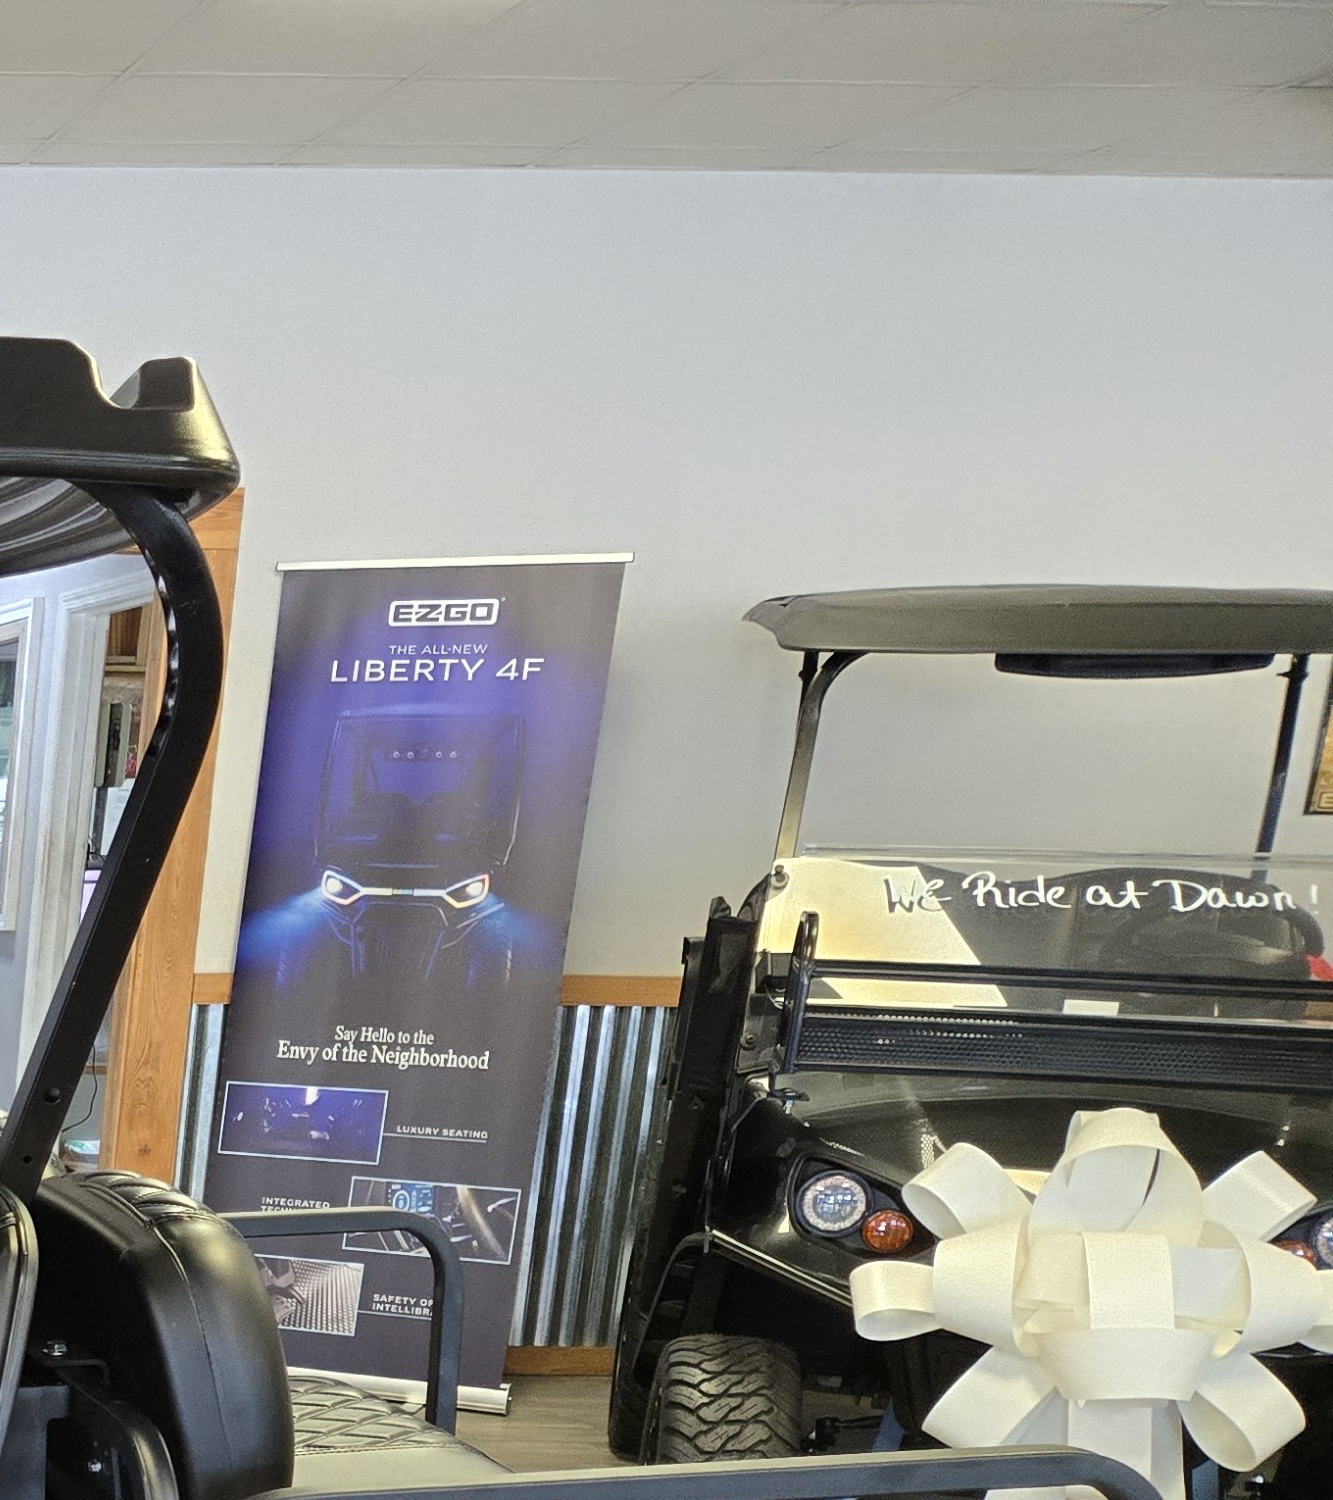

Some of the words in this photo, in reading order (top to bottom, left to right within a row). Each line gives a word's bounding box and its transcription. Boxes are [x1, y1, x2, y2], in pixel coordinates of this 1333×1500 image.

[390, 602, 497, 625] EZGO
[389, 644, 417, 656] THE
[421, 643, 489, 656] ALL-NEW
[330, 659, 485, 683] LIBERTY
[495, 658, 545, 682] 4F
[883, 877, 952, 914] We
[963, 871, 1073, 910] Ride
[1086, 879, 1149, 910] at
[335, 1025, 358, 1044] Say
[360, 1026, 395, 1043] Hello
[398, 1030, 411, 1044] to
[413, 1029, 435, 1045] the
[277, 1039, 320, 1065] Envy
[322, 1043, 341, 1061] of
[342, 1044, 368, 1063] the
[370, 1045, 490, 1070] Neighborhood
[396, 1125, 440, 1136] LUXURY
[442, 1128, 488, 1139] SEATING
[261, 1196, 331, 1209] INTEGRATED
[373, 1293, 417, 1305] SAFETY
